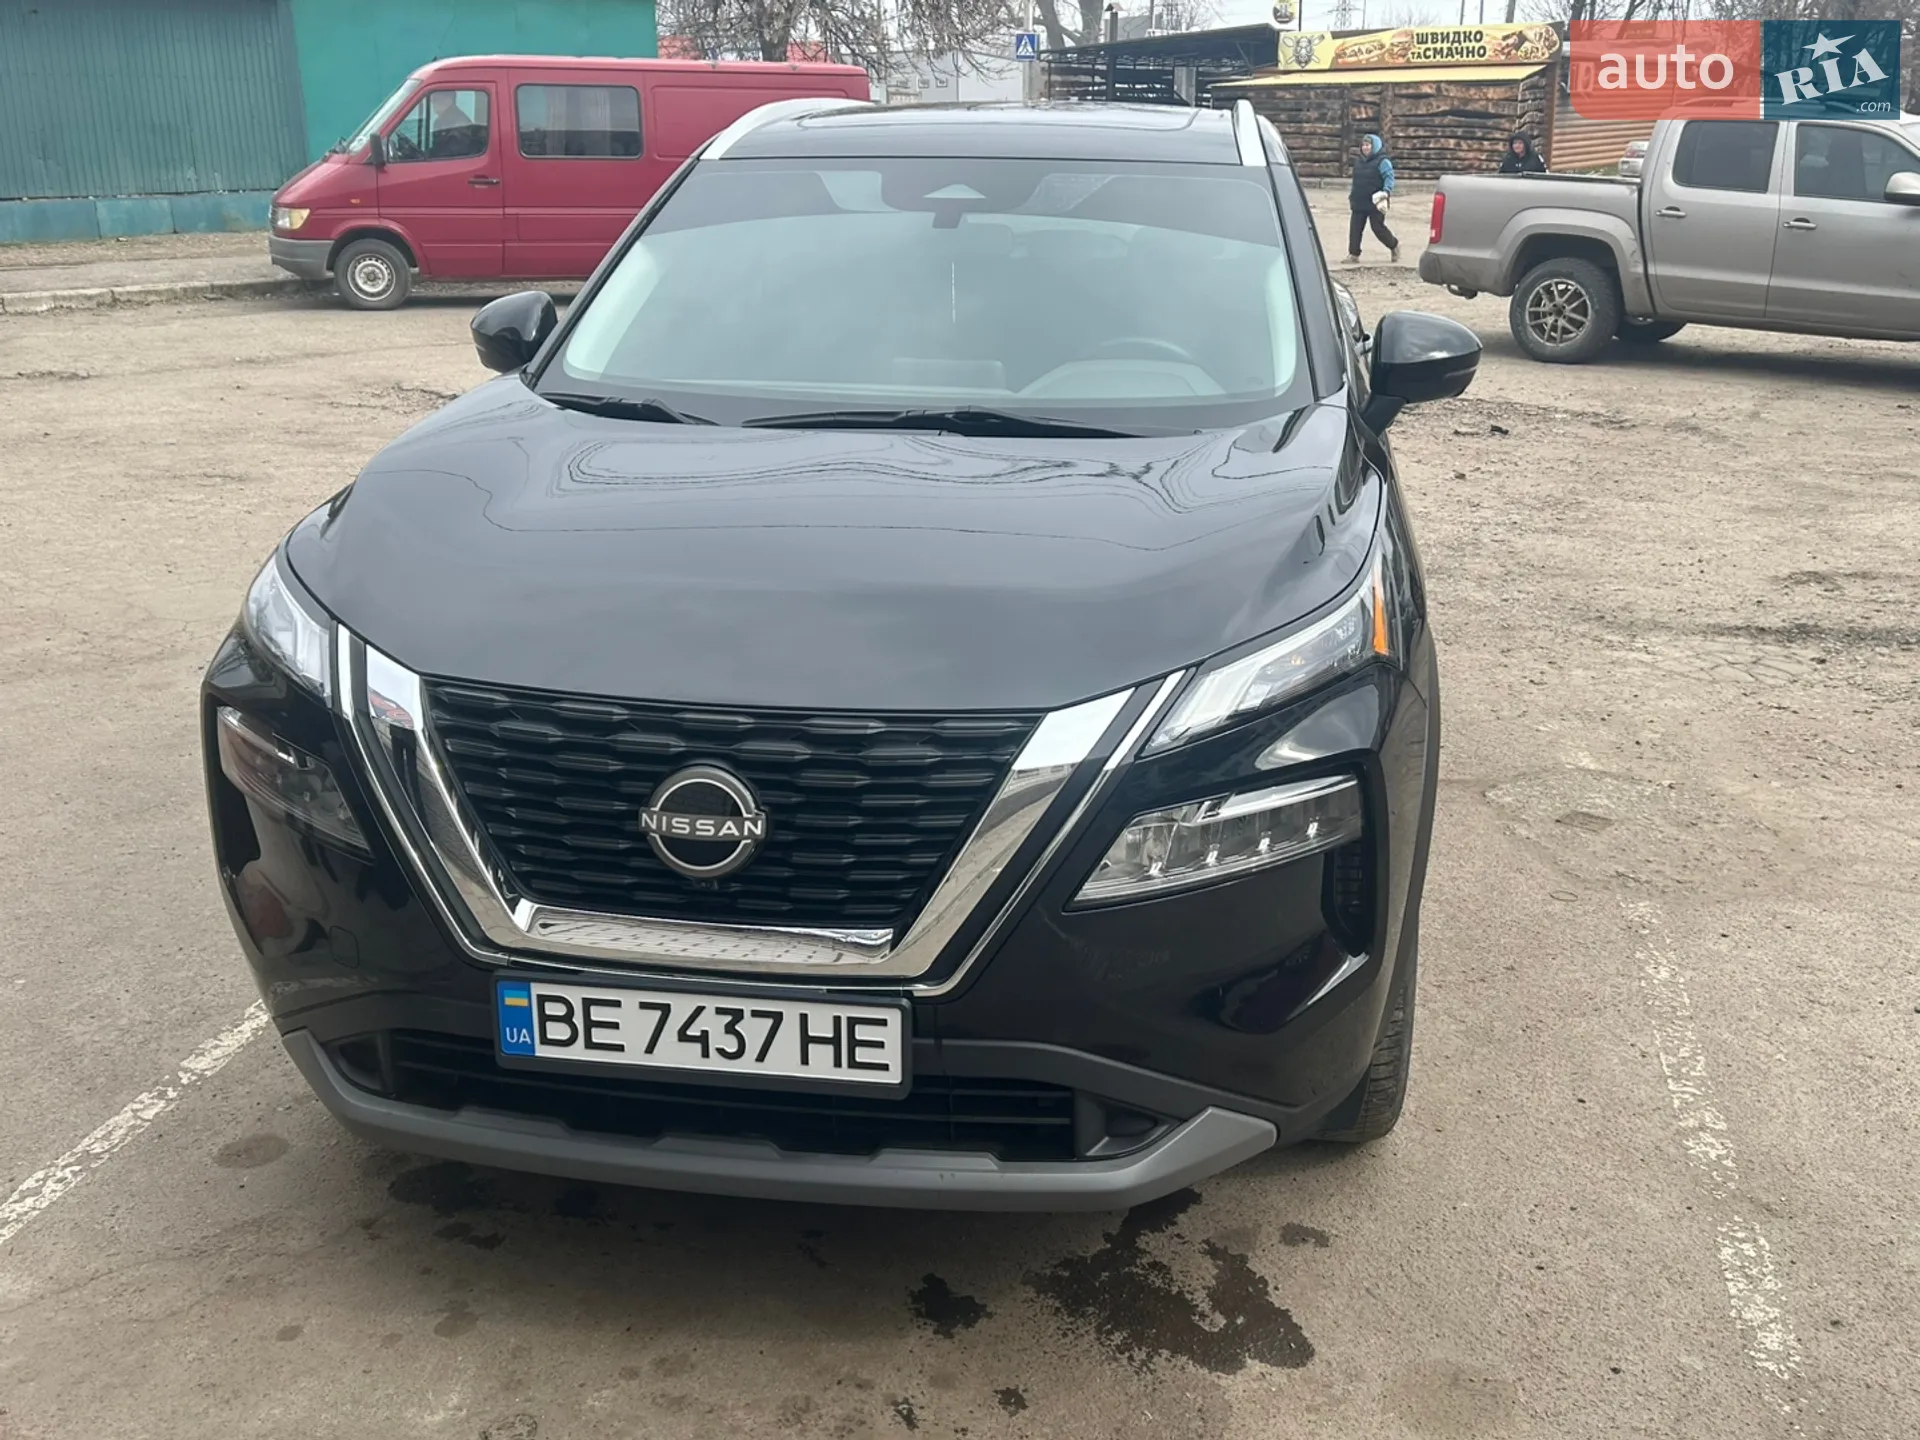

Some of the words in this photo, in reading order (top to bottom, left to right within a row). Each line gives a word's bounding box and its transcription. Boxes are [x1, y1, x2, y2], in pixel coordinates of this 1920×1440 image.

[1415, 30, 1484, 46] ШВИДКО
[641, 813, 762, 837] NISSAN
[505, 1026, 532, 1045] UA
[535, 993, 626, 1052] BE
[638, 1001, 784, 1063] 7437
[799, 1012, 890, 1072] HE
